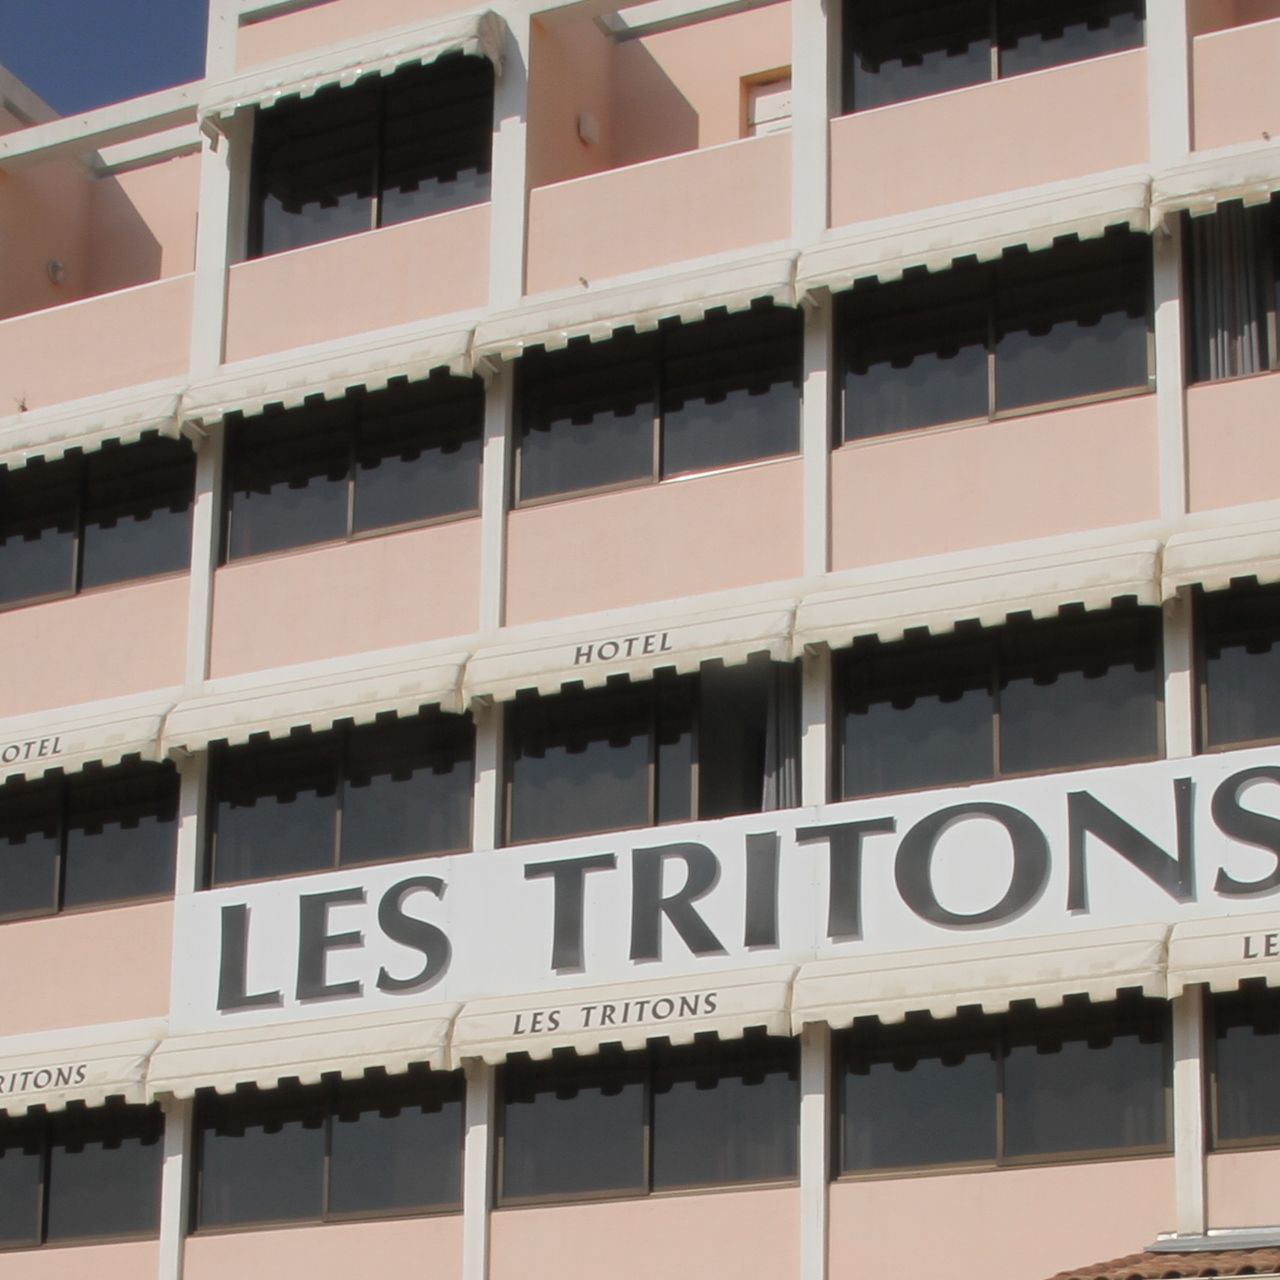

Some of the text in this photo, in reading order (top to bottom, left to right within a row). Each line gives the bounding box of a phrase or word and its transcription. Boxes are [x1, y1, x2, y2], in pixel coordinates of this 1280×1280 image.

[573, 631, 674, 666] HOTEL
[216, 874, 453, 1012] LES
[512, 992, 717, 1035] LES TRITONS
